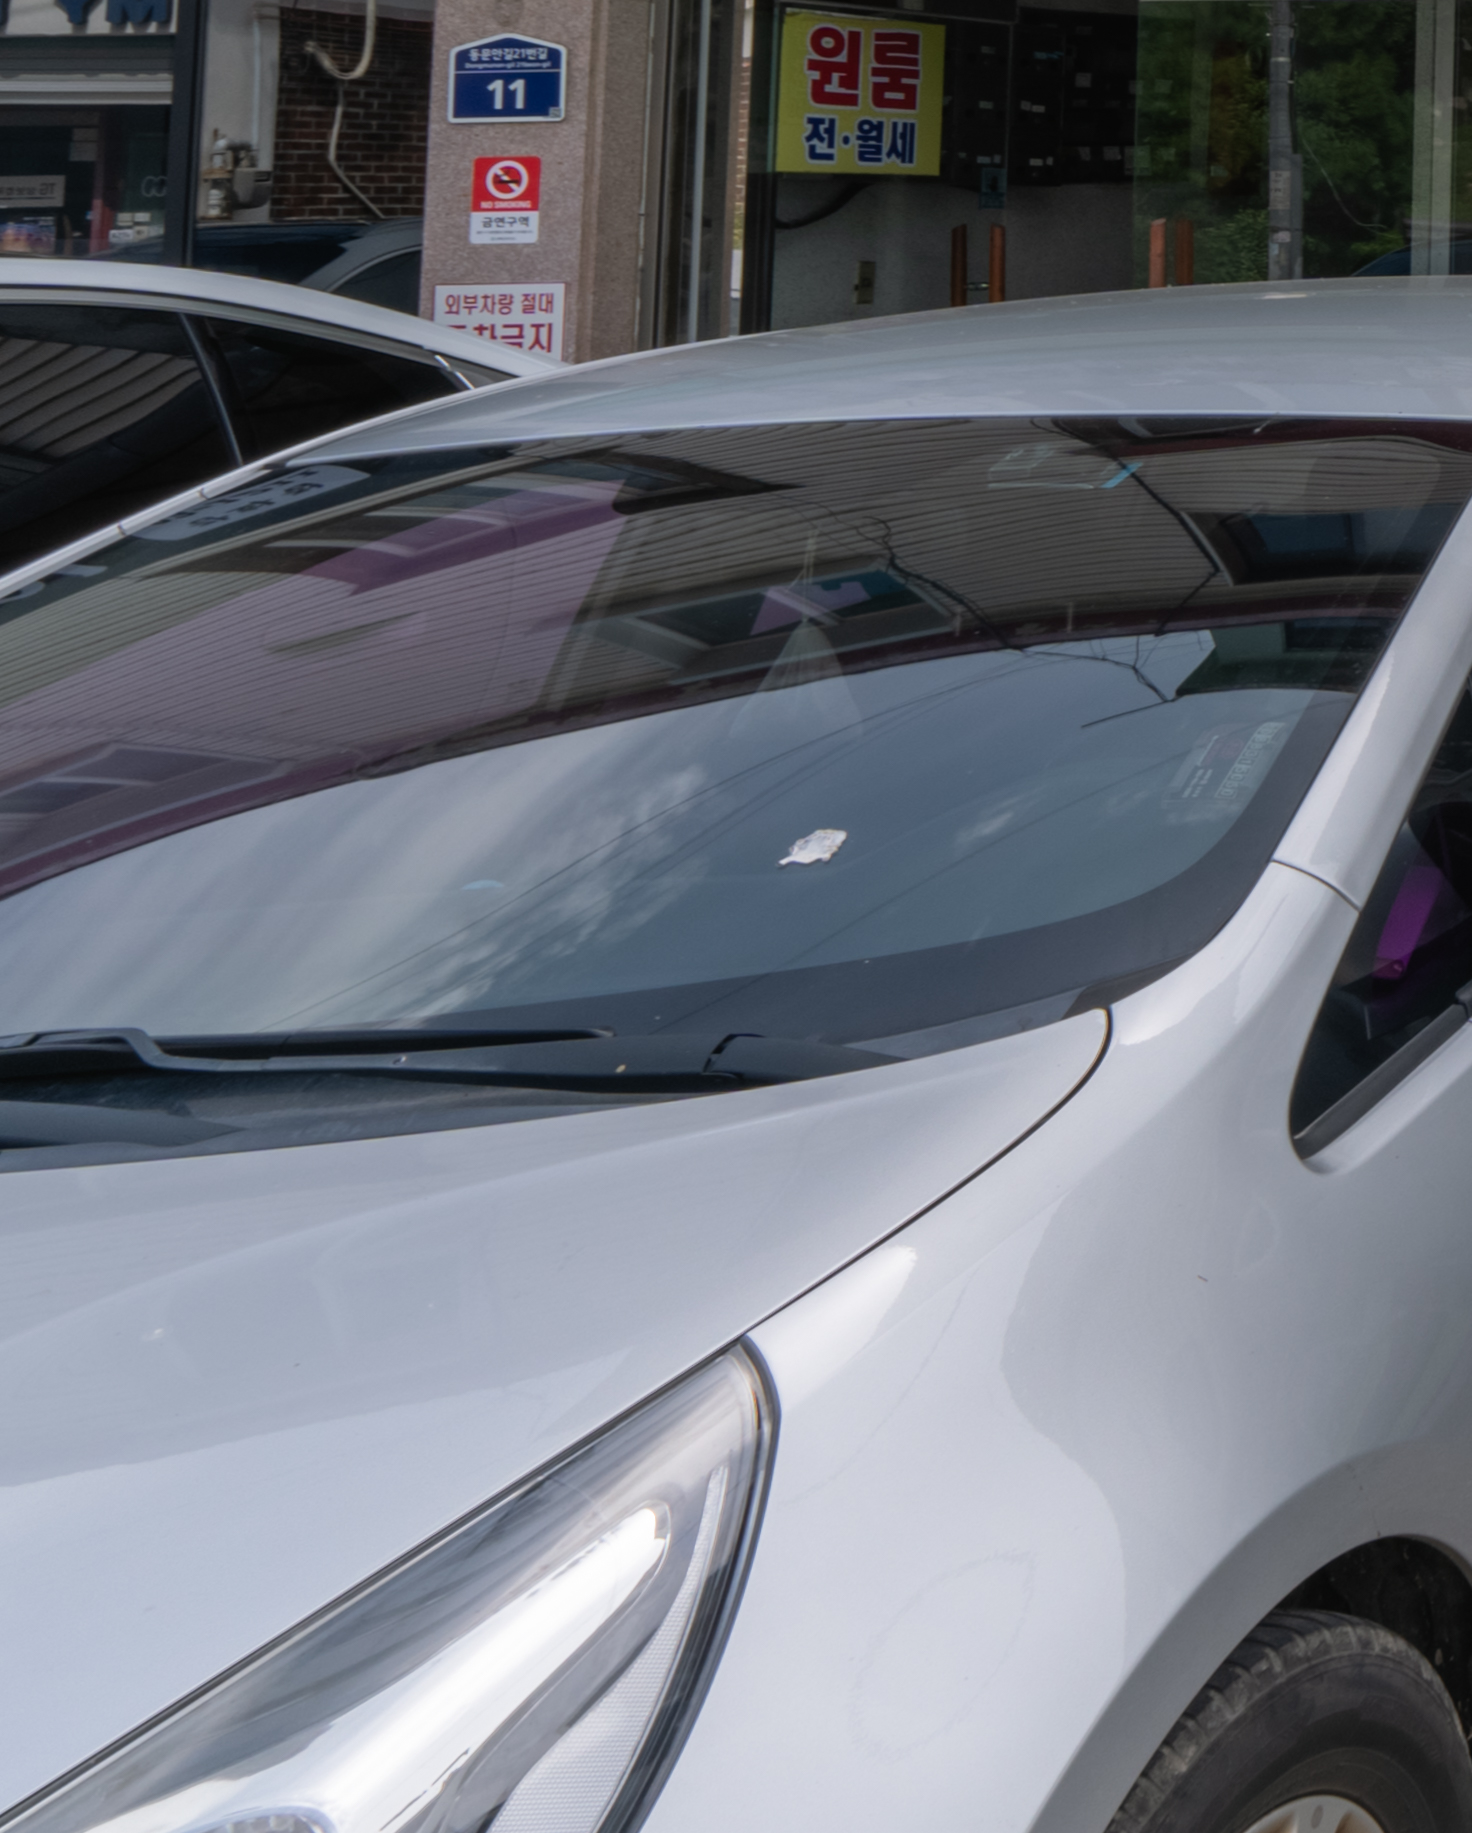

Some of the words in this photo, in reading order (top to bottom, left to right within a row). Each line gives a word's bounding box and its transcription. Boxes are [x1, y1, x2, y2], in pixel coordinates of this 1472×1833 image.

[806, 25, 922, 112] 원룸
[486, 79, 526, 110] 11
[804, 116, 917, 166] 전·월세
[481, 215, 530, 228] 금연구역
[444, 293, 515, 316] 외부차량
[521, 292, 555, 315] 절대
